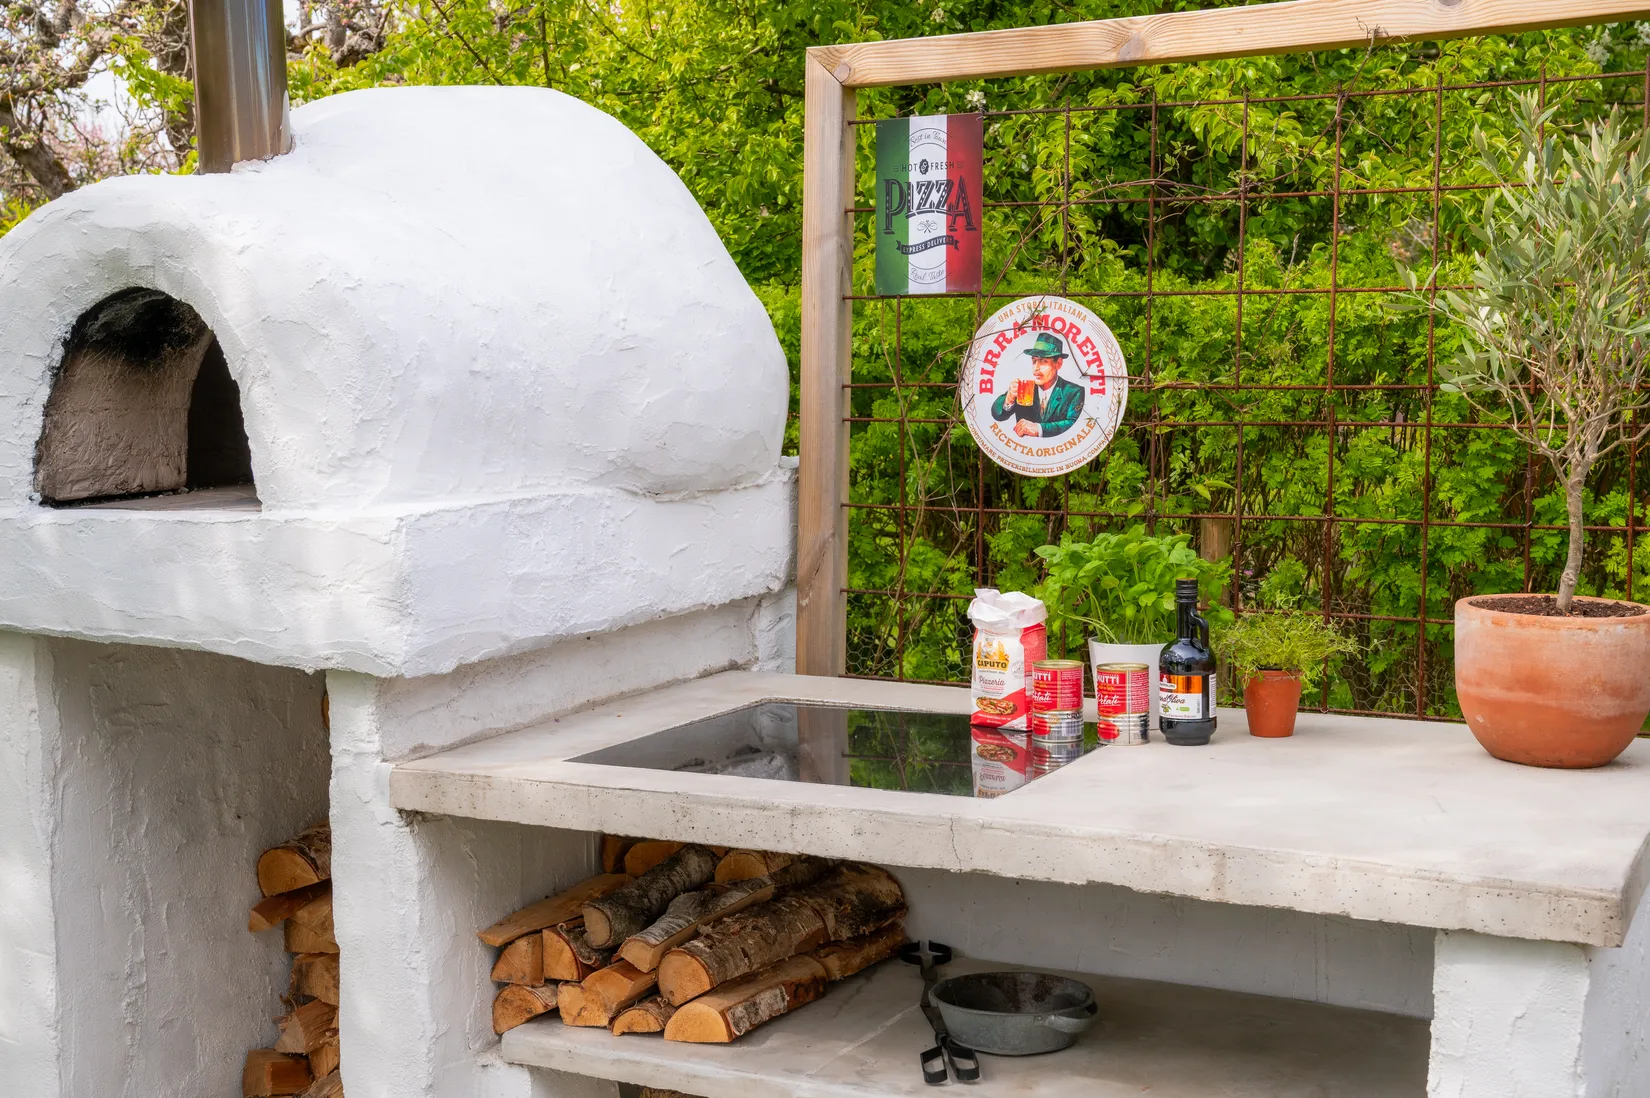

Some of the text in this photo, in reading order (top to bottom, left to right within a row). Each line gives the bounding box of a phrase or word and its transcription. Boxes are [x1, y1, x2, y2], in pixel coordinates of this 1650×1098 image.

[924, 132, 931, 140] in
[901, 163, 918, 172] HOT
[930, 161, 955, 171] FRESH
[883, 175, 977, 235] PIZZA
[902, 236, 953, 253] EXPRESS DELIVERY
[910, 267, 927, 281] Real
[998, 308, 1015, 323] UNA
[1049, 300, 1088, 323] ITALIANA
[979, 314, 1106, 396] BIRRA MORETTI
[989, 419, 1096, 457] RICETTA ORIGINALE
[969, 422, 997, 458] CONSUMARE
[996, 454, 1056, 474] PREFERIBILMENTE
[1056, 465, 1065, 473] IN
[1065, 455, 1088, 469] BUONA
[977, 660, 1007, 669] CAPUTO
[978, 675, 1006, 686] Pizzeria
